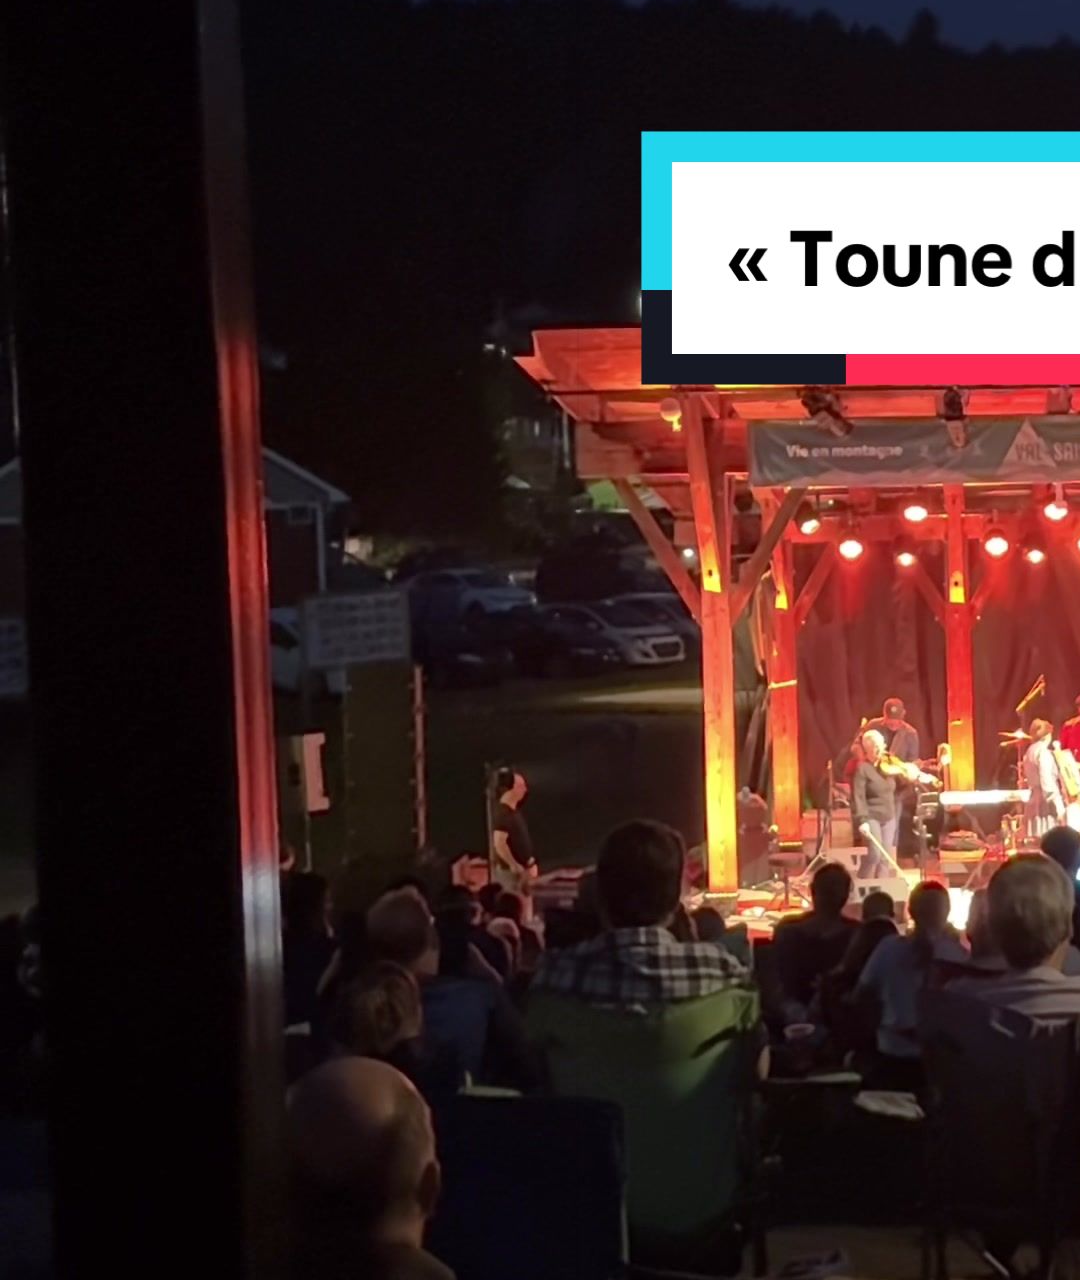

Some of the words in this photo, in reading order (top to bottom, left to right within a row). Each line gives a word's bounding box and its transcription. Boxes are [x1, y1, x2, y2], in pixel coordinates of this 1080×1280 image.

[786, 445, 808, 458] Vie
[812, 447, 828, 457] en
[832, 445, 903, 459] montagne
